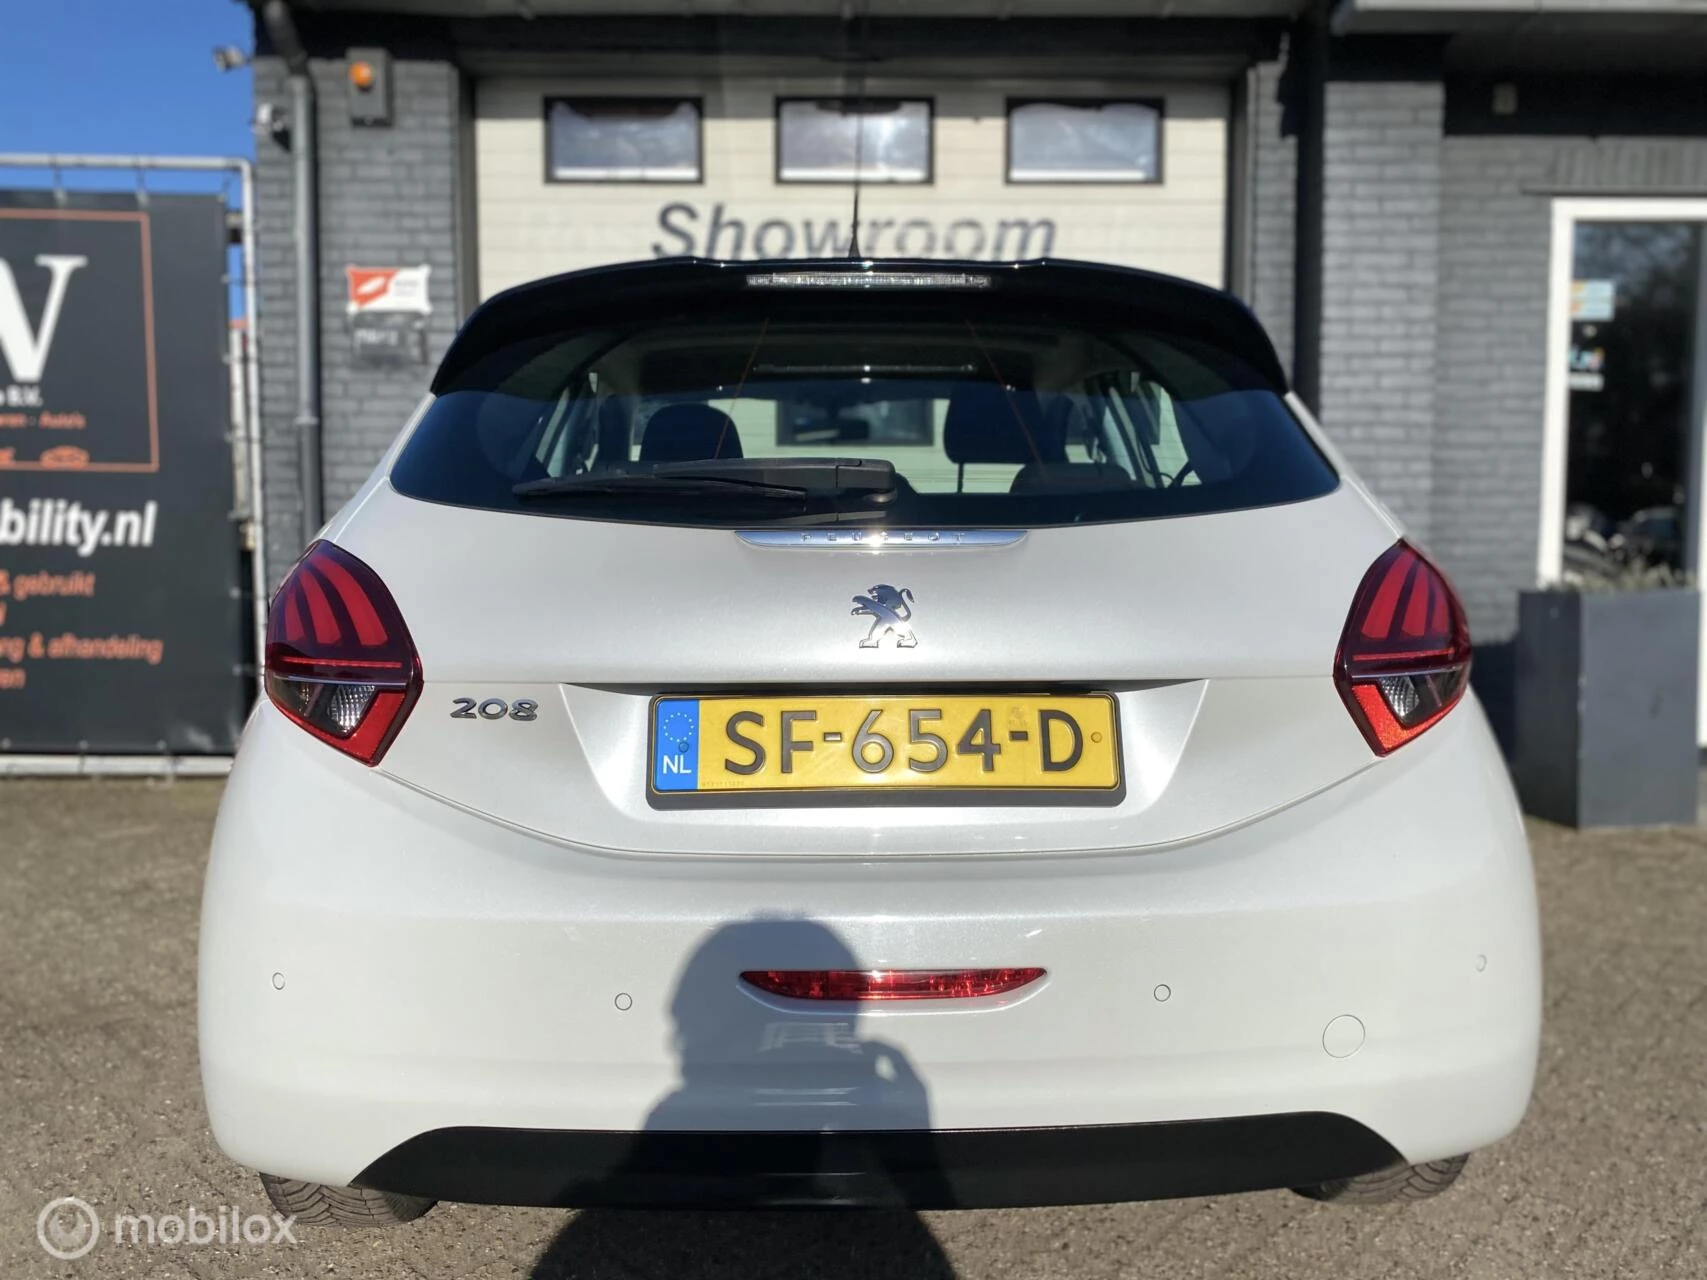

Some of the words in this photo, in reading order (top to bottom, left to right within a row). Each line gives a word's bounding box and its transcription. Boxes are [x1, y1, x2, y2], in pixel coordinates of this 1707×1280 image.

[652, 201, 1058, 260] Showroom
[450, 697, 539, 722] 208
[724, 708, 1083, 776] SF-654-D
[663, 754, 692, 775] NL
